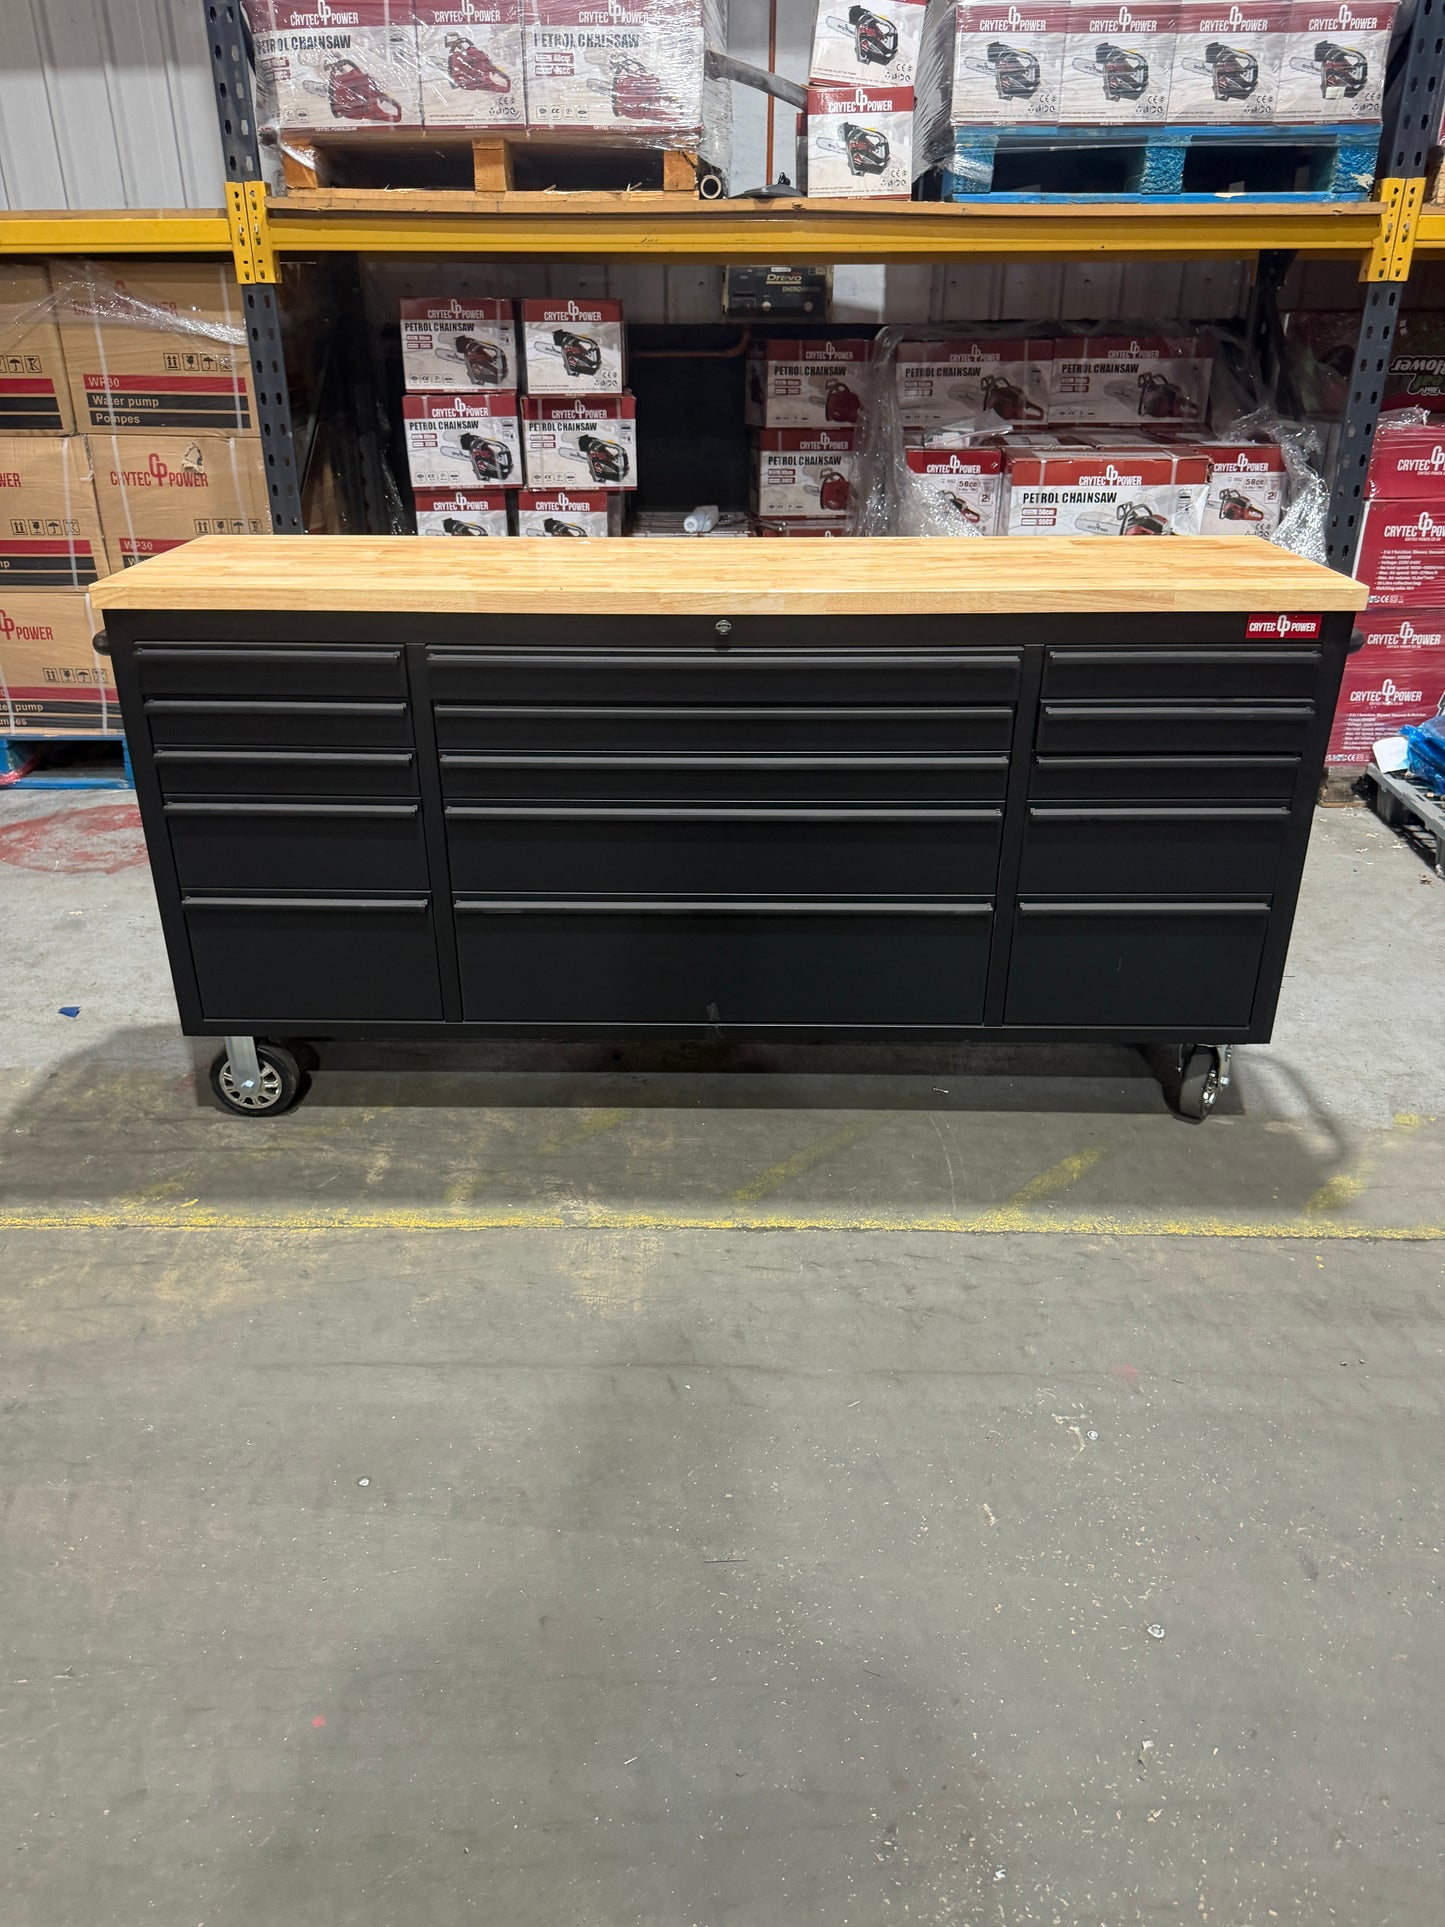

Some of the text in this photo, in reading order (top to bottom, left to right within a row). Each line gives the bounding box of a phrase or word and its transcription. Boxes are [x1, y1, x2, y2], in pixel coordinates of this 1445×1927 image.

[290, 11, 319, 26] CRYTEC
[332, 12, 359, 24] POWER
[434, 10, 462, 22] CRYTEC
[474, 10, 500, 22] POWER
[579, 11, 608, 23] CRYTEC
[980, 19, 1008, 32] CRYTEC
[1020, 19, 1046, 31] POWER
[1090, 20, 1118, 32] CRYTEC
[1130, 20, 1157, 32] POWER
[1200, 20, 1229, 32] CRYTEC
[1240, 20, 1268, 32] POWER
[1308, 18, 1338, 31] CRYTEC
[1350, 18, 1377, 29] POWER
[292, 35, 351, 50] CHAINSAW
[829, 101, 856, 113] CRYTEC
[868, 100, 892, 112] POWER
[428, 310, 452, 318] CRYTEC
[462, 310, 484, 318] POWER
[544, 312, 568, 321] CRYTEC
[579, 312, 601, 321] POWER
[405, 323, 474, 331] PETROL CHAINSAW
[805, 366, 846, 376] CHAINSAW
[937, 367, 981, 377] CHAINSAW
[1094, 364, 1139, 373] CHAINSAW
[128, 398, 159, 408] pump
[432, 408, 456, 418] CRYTEC
[466, 408, 488, 416] POWER
[552, 410, 576, 419] CRYTEC
[585, 410, 607, 418] POWER
[409, 421, 479, 431] PETROL CHAINSAW
[558, 423, 597, 431] CHAINSAW
[799, 456, 841, 465] CHAINSAW
[1397, 459, 1430, 471] CRYTEC
[927, 464, 950, 473] CRYTEC
[960, 465, 981, 473] POWER
[1214, 463, 1237, 472] CRYTEC
[1246, 463, 1269, 472] POWER
[169, 472, 208, 487] POWER
[1078, 476, 1105, 486] CRYTEC
[1117, 476, 1142, 486] POWER
[1023, 492, 1117, 504] PETROL CHAINSAW
[433, 502, 457, 511] CRYTEC
[467, 502, 488, 510] POWER
[536, 502, 559, 511] CRYTEC
[568, 502, 590, 511] POWER
[1384, 525, 1418, 537] CRYTEC
[1249, 622, 1276, 632] CRYTEC
[1291, 622, 1316, 632] POWER
[16, 626, 54, 640] POWER
[1367, 634, 1399, 645] CRYTEC
[1411, 634, 1441, 645] POWER
[1350, 691, 1382, 702] CRYTEC
[1393, 691, 1422, 702] POWER
[15, 704, 43, 712] pump
